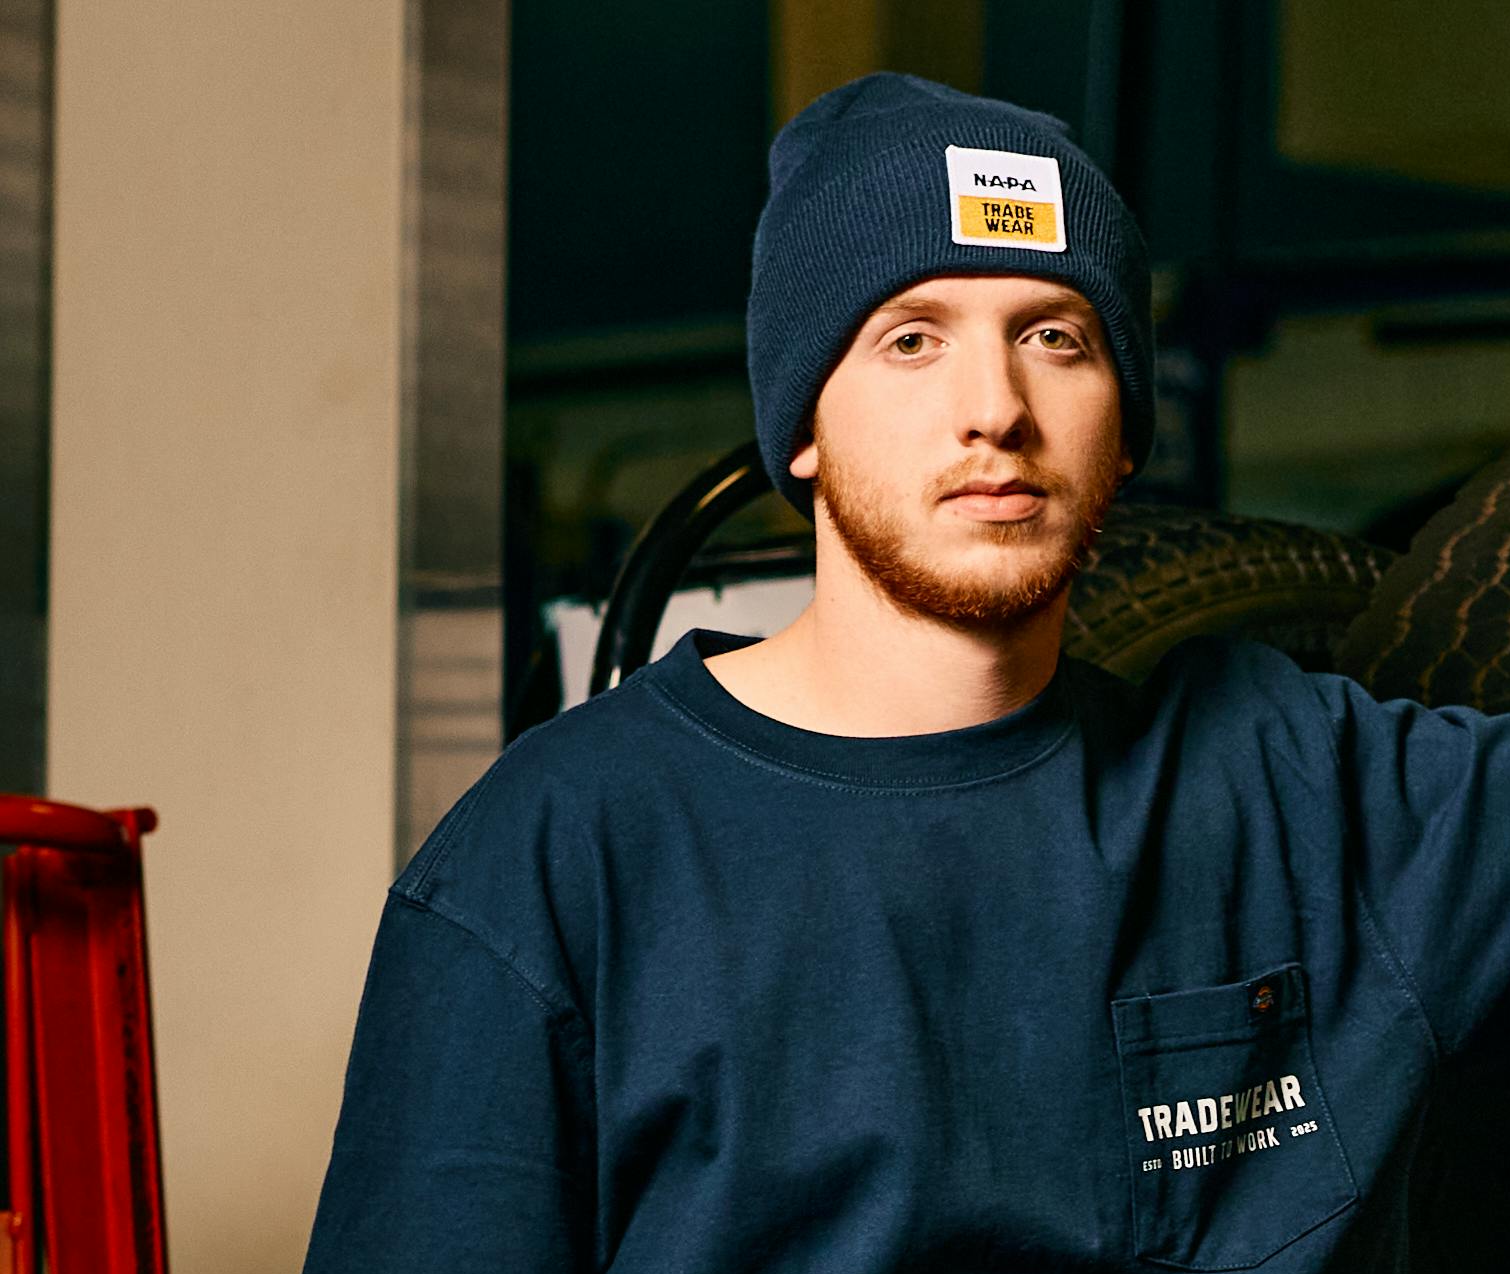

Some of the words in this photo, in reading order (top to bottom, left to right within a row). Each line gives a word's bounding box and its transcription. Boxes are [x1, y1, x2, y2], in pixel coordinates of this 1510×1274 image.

[982, 202, 1034, 220] TRADE
[986, 218, 1034, 235] WEAR
[1137, 1074, 1306, 1142] TRADEWEAR
[1171, 1144, 1216, 1170] BUILT
[1221, 1140, 1233, 1160] TO
[1236, 1126, 1280, 1154] WORK
[1289, 1120, 1319, 1137] 2025
